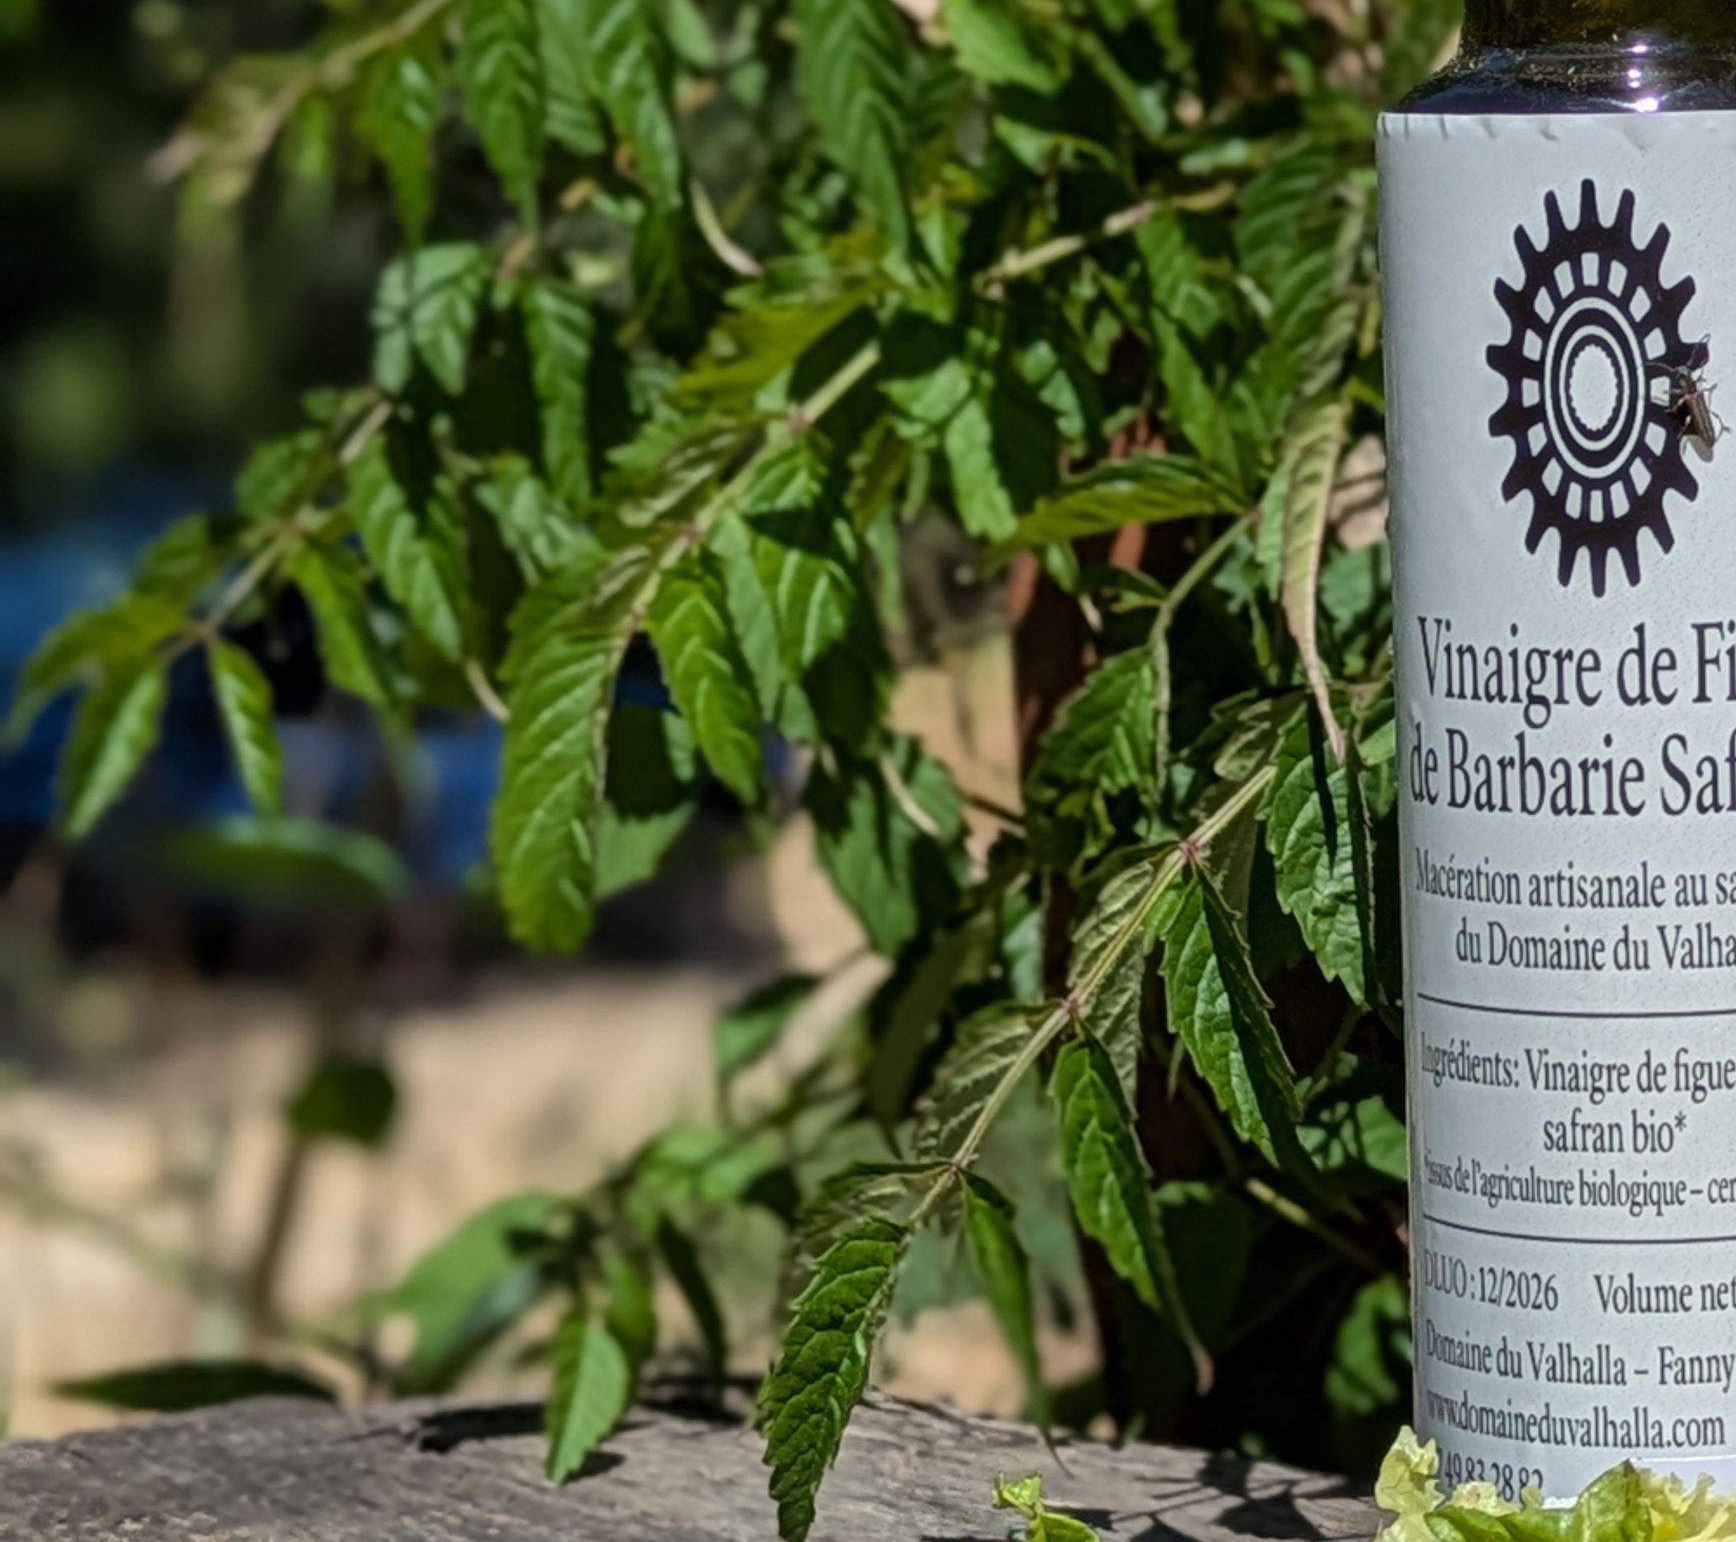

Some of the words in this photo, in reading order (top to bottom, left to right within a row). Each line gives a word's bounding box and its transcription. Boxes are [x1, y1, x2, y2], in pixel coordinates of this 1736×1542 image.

[1416, 615, 1602, 729] Vinaigre
[1617, 623, 1678, 706] de
[1410, 723, 1438, 806] de
[1446, 727, 1646, 816] Barbarie
[1415, 846, 1522, 905] Macération
[1528, 861, 1666, 908] artisanale
[1674, 873, 1708, 905] au
[1456, 916, 1481, 963] du
[1487, 921, 1605, 970] Domaine
[1613, 925, 1650, 970] du
[1421, 1031, 1519, 1088] Ingrédients:
[1524, 1047, 1630, 1105] Vinaigre
[1637, 1050, 1667, 1093] de
[1674, 1049, 1736, 1102] figue
[1543, 1108, 1624, 1153] safran
[1454, 1156, 1470, 1194] de
[1579, 1168, 1686, 1216] biologique
[1593, 1274, 1693, 1314] Volume
[1427, 1319, 1492, 1374] Domaine
[1496, 1335, 1523, 1378] du
[1525, 1340, 1627, 1386] Valhalla
[1657, 1345, 1735, 1392] Fanny
[1427, 1389, 1726, 1449] www.domaineduvalhalla.com
